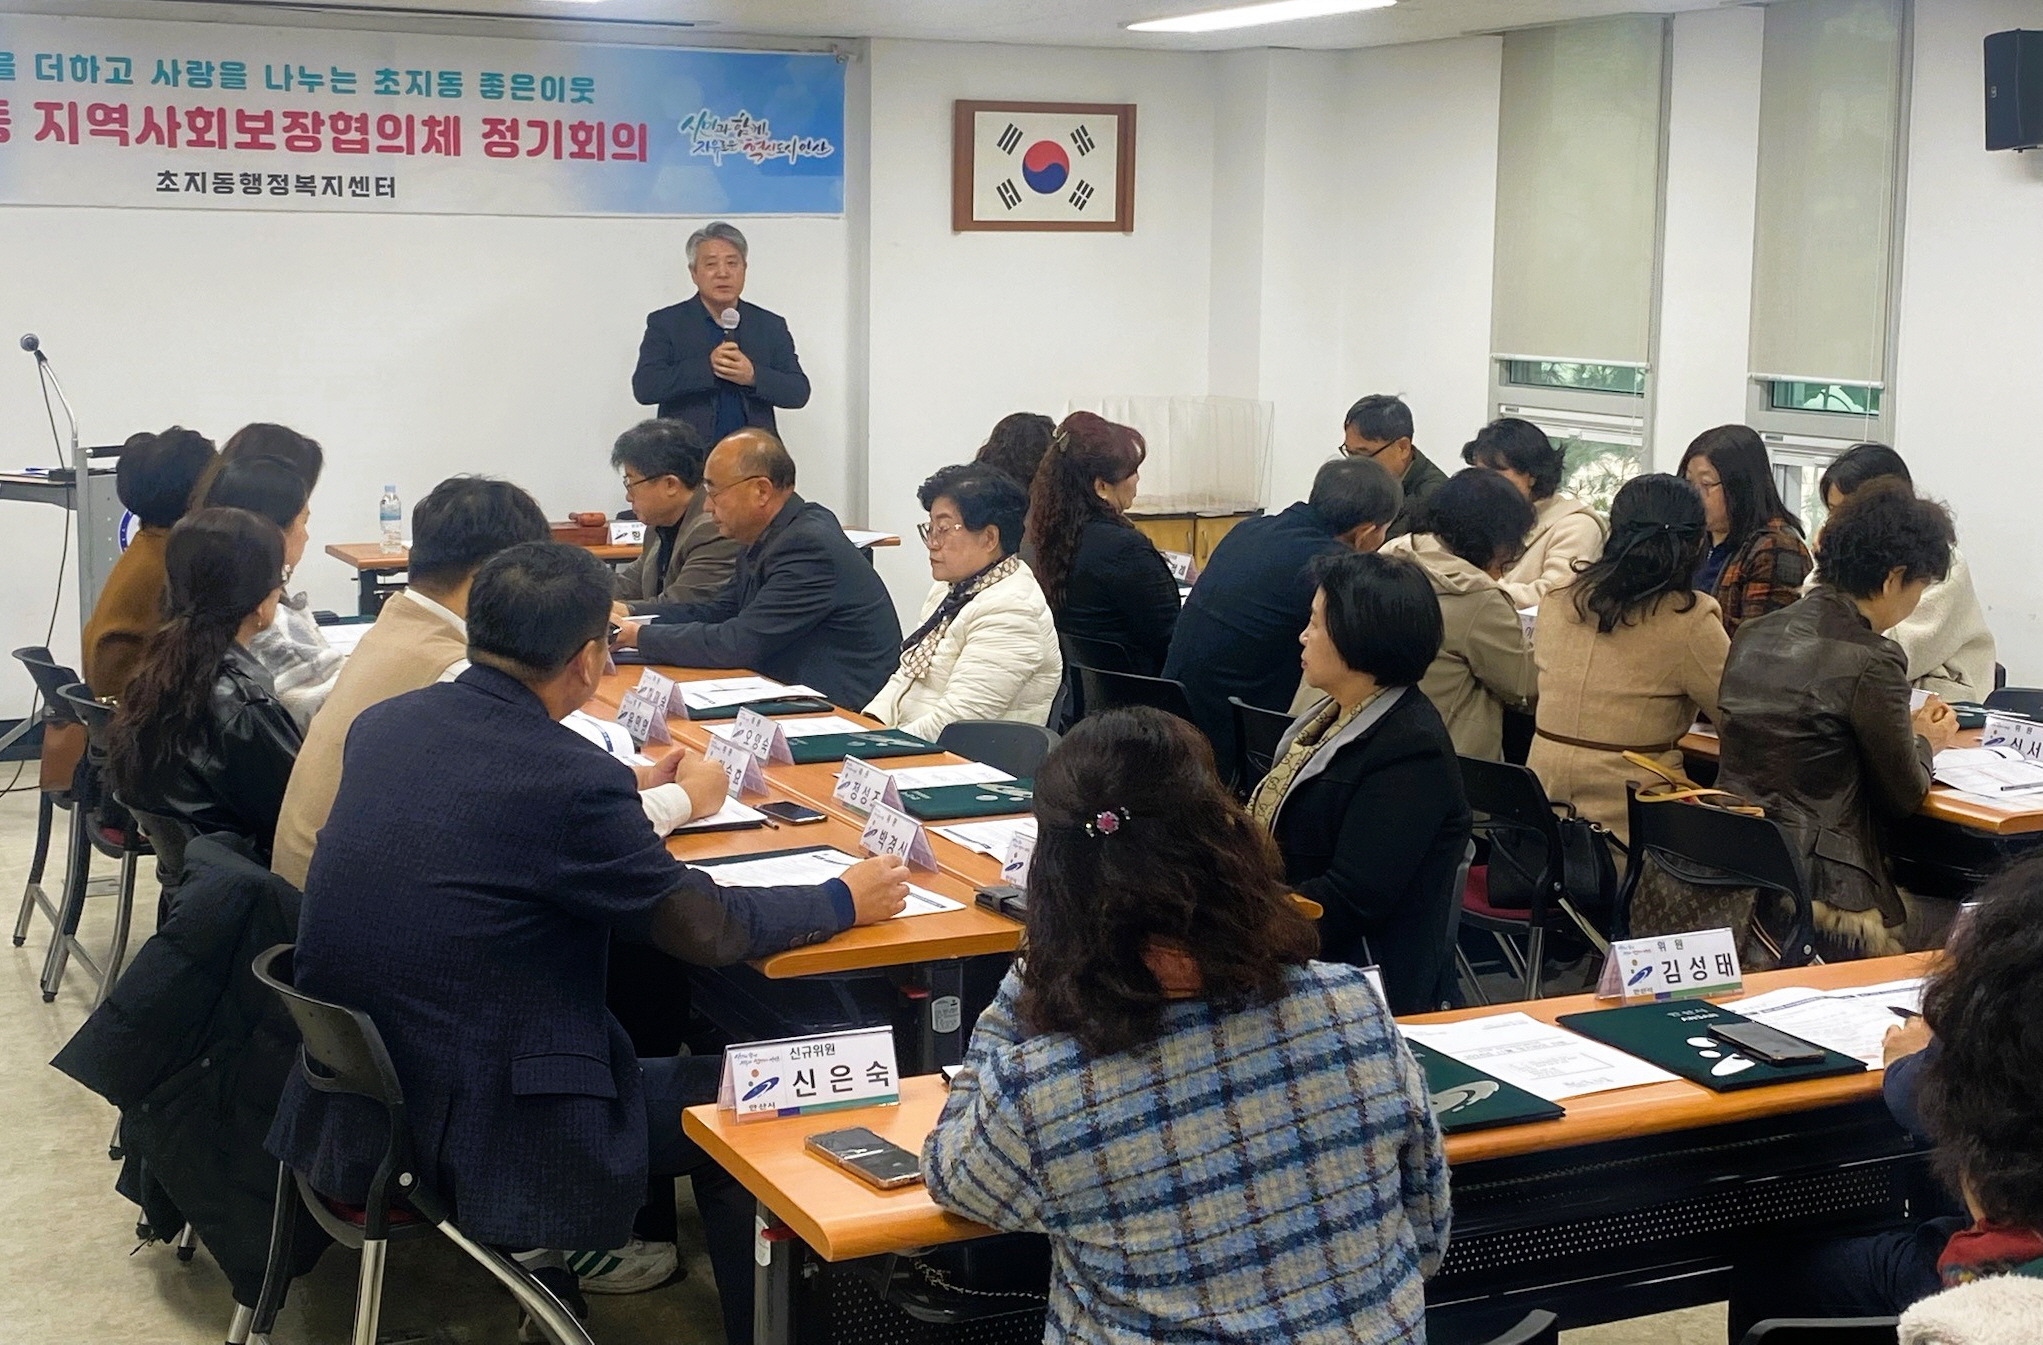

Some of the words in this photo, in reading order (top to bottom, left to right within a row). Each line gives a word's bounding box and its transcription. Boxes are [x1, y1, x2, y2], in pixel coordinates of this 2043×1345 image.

[35, 53, 134, 85] 더하고
[151, 59, 248, 90] 사랑을
[265, 64, 357, 95] 나누는
[374, 68, 464, 98] 초지동
[479, 71, 595, 104] 좋은이웃
[34, 101, 461, 157] 지역사회보장협의체
[481, 117, 647, 163] 정기회의
[156, 169, 397, 198] 초지동행정복지센터
[1661, 953, 1735, 984] 김성태
[789, 1043, 836, 1060] 신규위원
[792, 1060, 890, 1098] 신은숙
